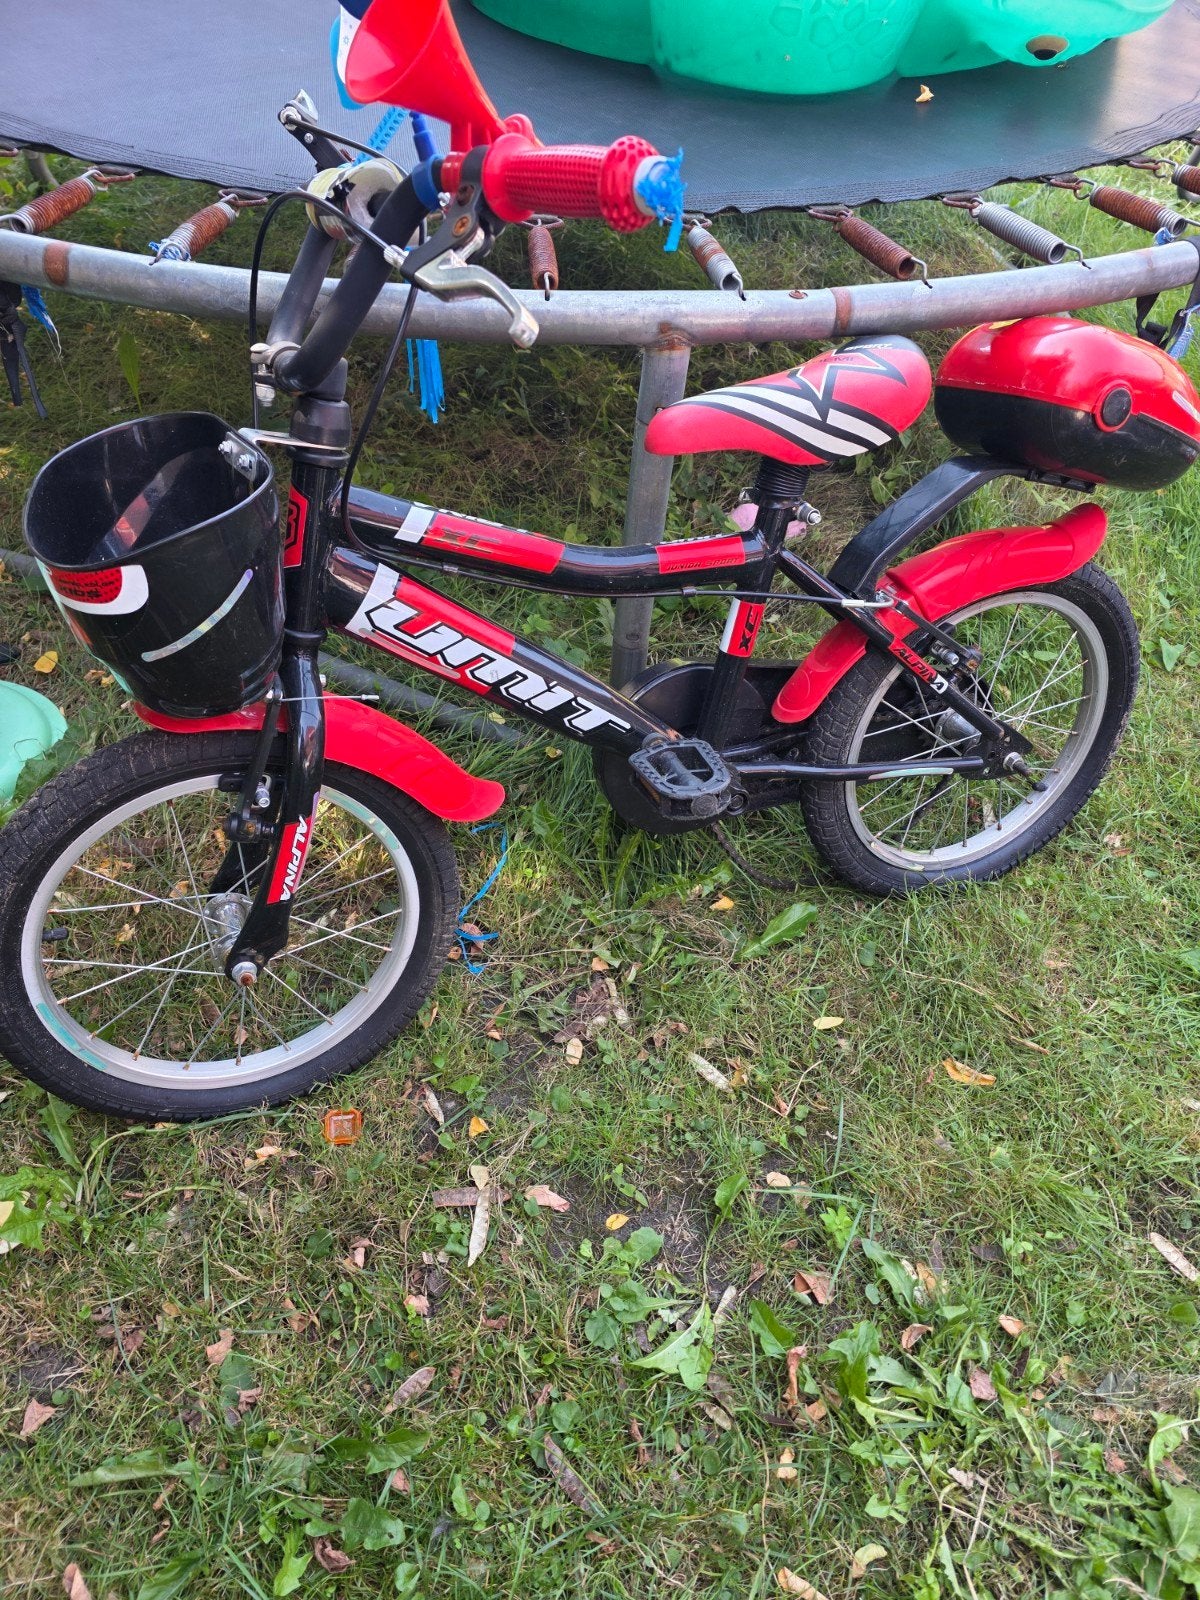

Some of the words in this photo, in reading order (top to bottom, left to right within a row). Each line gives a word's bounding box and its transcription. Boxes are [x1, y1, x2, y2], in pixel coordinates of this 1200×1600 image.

[666, 561, 702, 571] JUNIOR
[705, 557, 739, 567] SPORT
[892, 647, 945, 691] ALPINA
[279, 814, 308, 901] ALPINA
